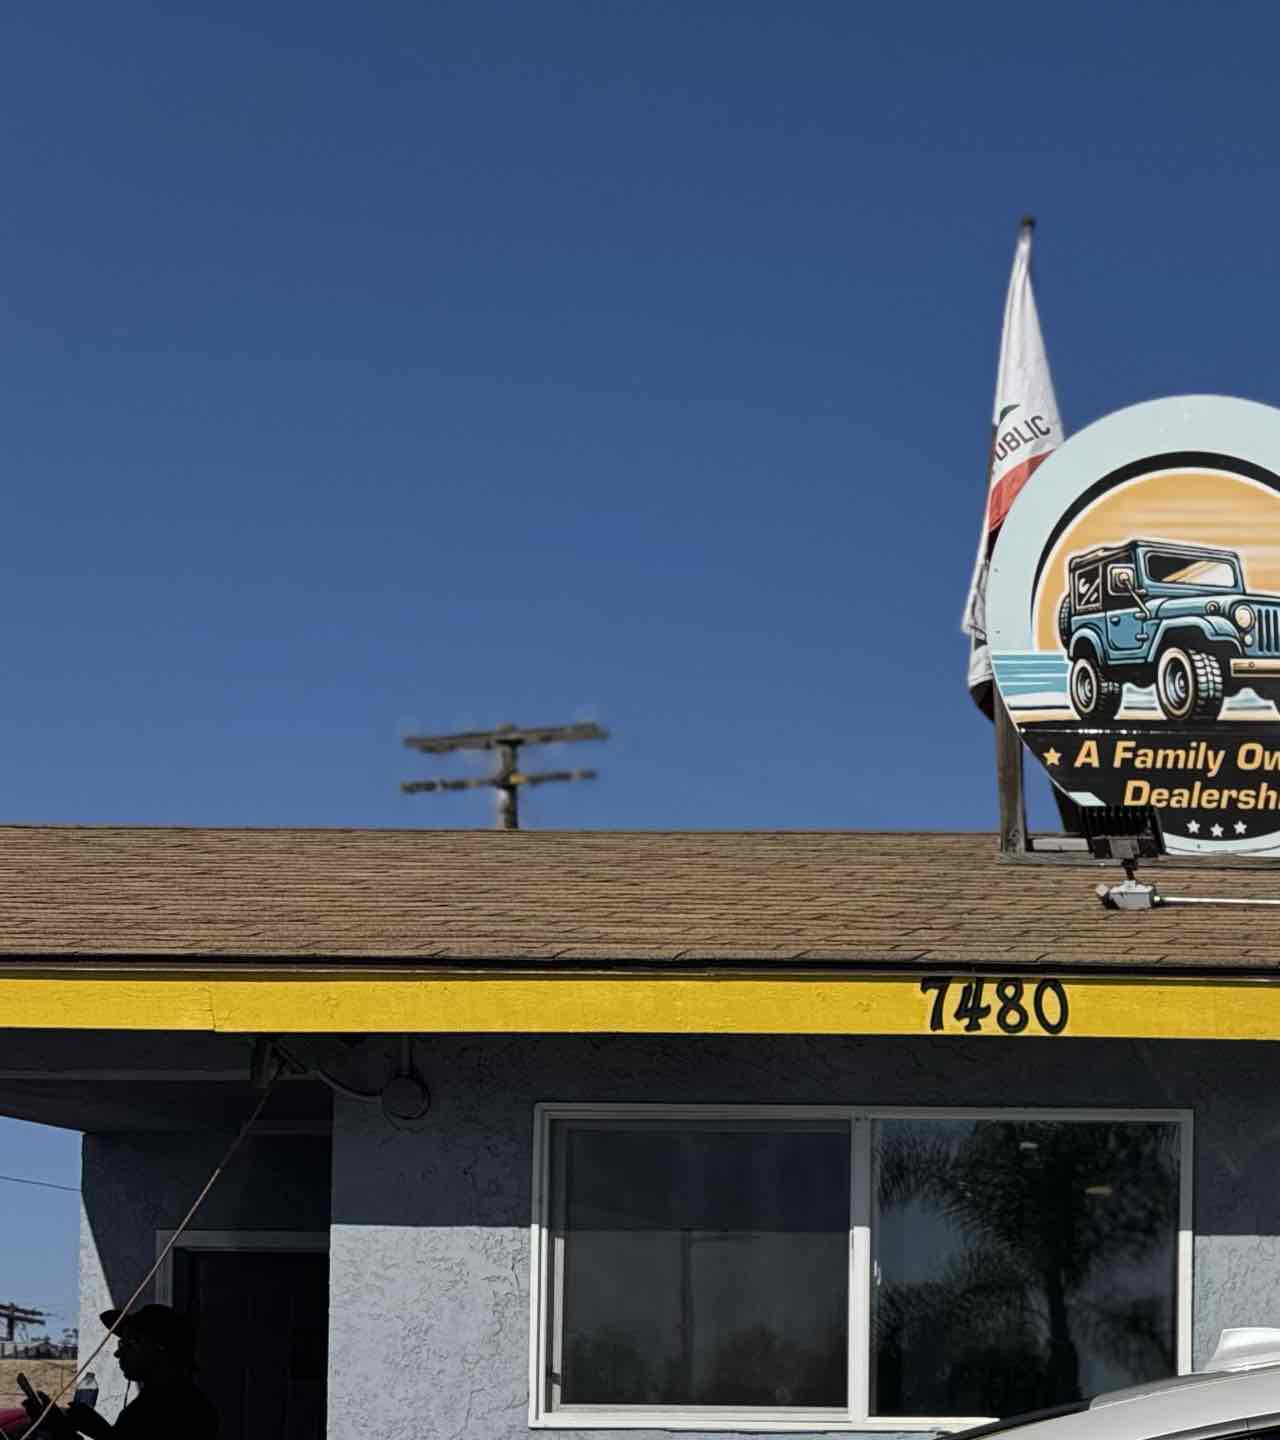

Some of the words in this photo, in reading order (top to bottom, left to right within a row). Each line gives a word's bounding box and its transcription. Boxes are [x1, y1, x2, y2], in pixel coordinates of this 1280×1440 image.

[1074, 740, 1100, 768] A
[1113, 740, 1227, 776] Family
[920, 976, 1069, 1034] 7480
